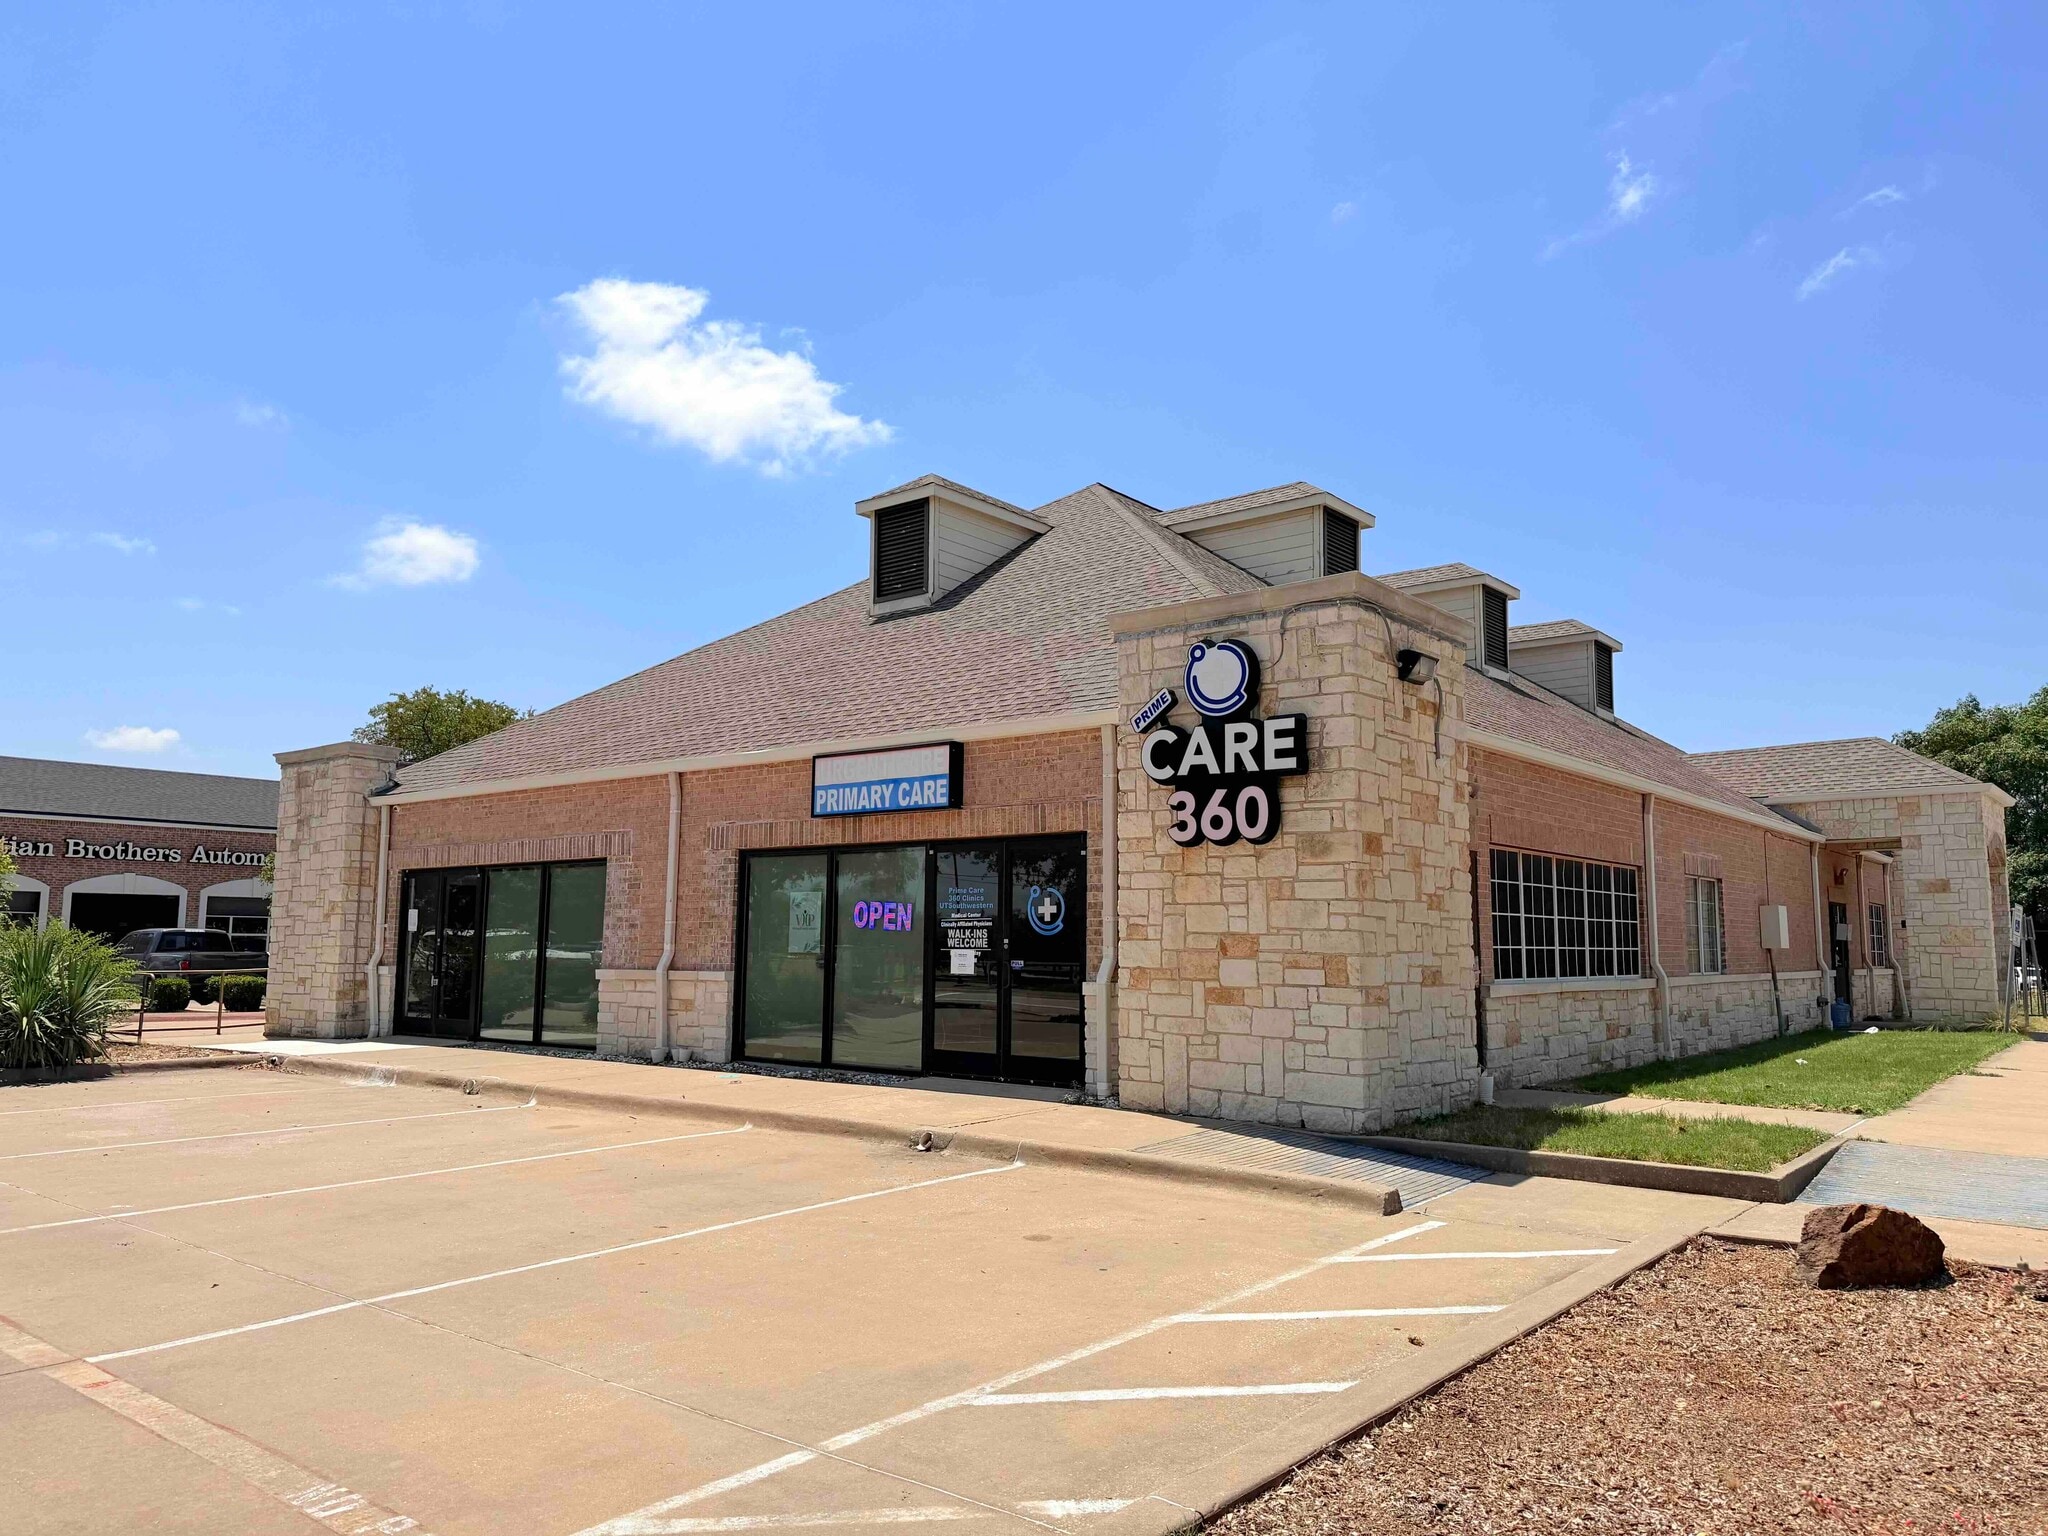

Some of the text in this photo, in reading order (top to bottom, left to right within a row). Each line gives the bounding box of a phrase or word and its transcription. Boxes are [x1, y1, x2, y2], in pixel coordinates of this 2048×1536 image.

[1133, 691, 1170, 730] PRIME
[1141, 717, 1297, 780] CARE
[816, 778, 947, 813] PRIMARY CARE
[1167, 785, 1269, 842] 360
[64, 838, 182, 863] Brothers
[189, 845, 266, 866] Autom
[948, 894, 985, 902] 360 Clinics
[968, 886, 985, 894] Care
[853, 900, 913, 932] OPEN
[947, 928, 989, 948] WALK-INS WELCOME
